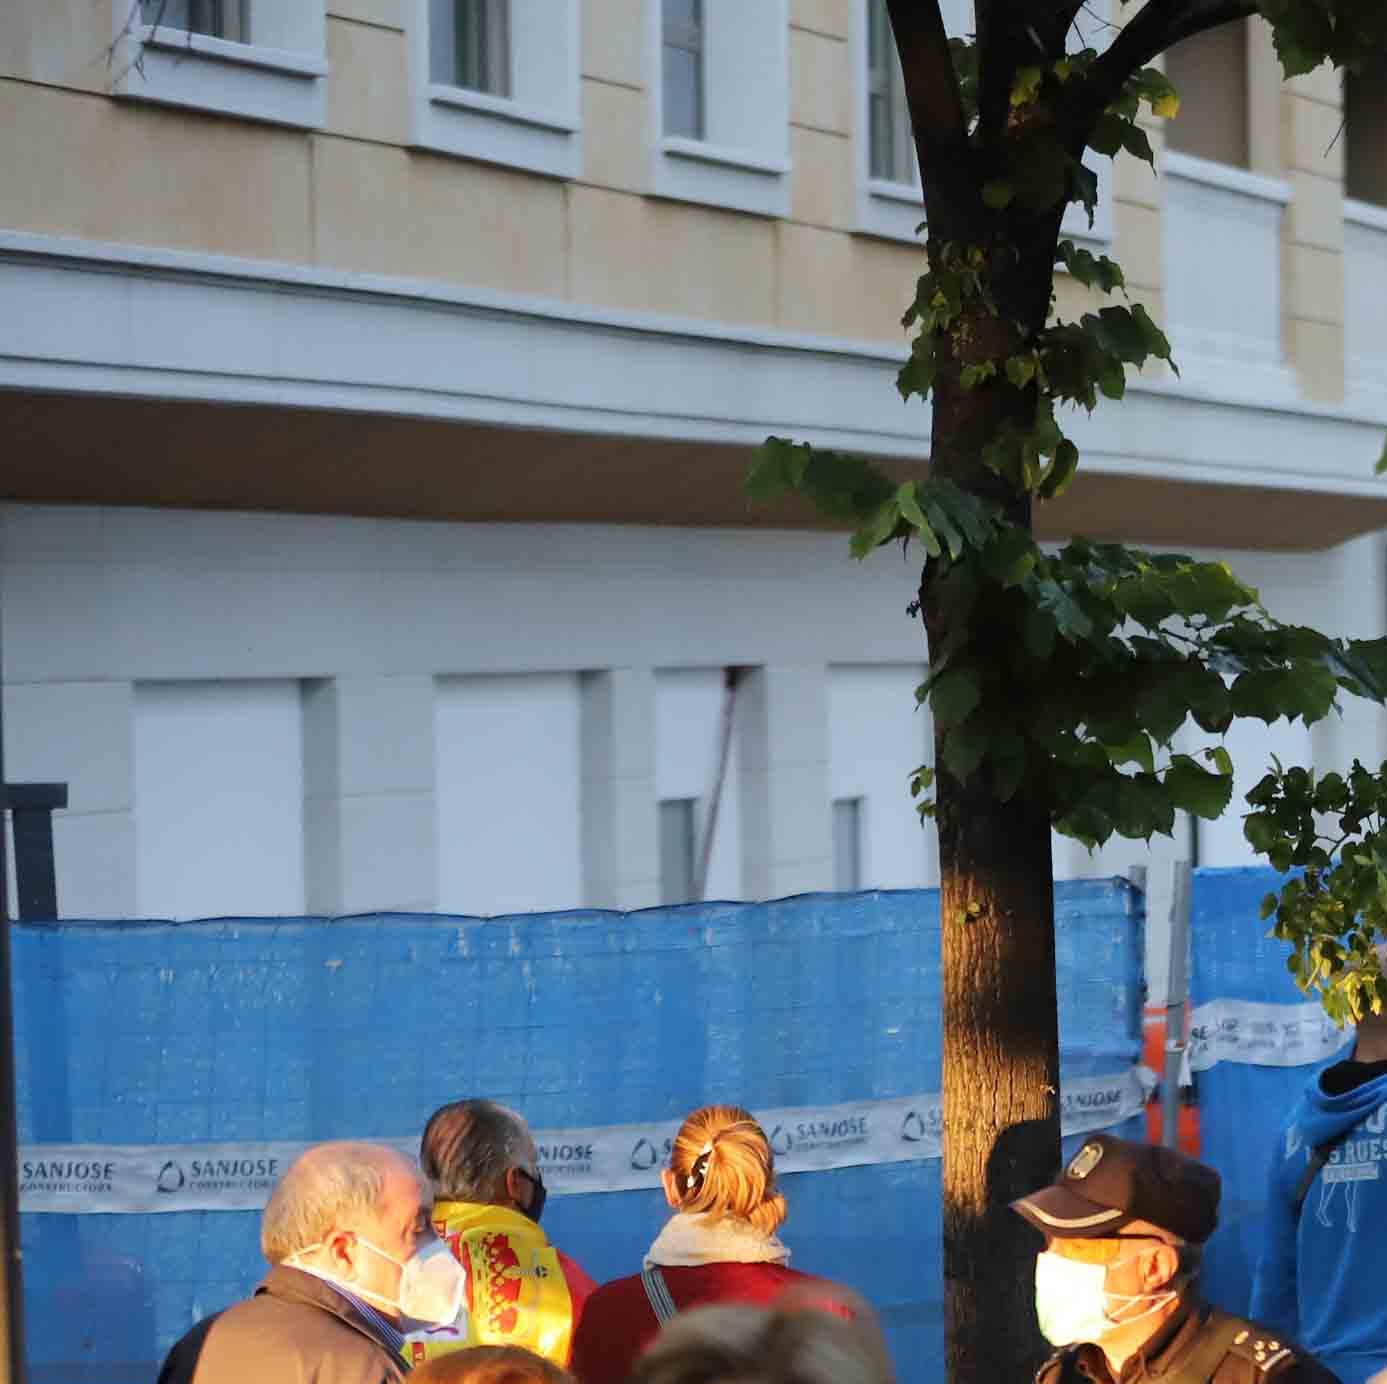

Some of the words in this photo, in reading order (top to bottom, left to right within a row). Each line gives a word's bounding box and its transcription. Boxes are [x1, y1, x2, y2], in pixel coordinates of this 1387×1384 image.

[538, 1143, 593, 1161] NJOSE
[23, 1161, 117, 1179] SANJOSE
[191, 1159, 279, 1177] SANJOSE
